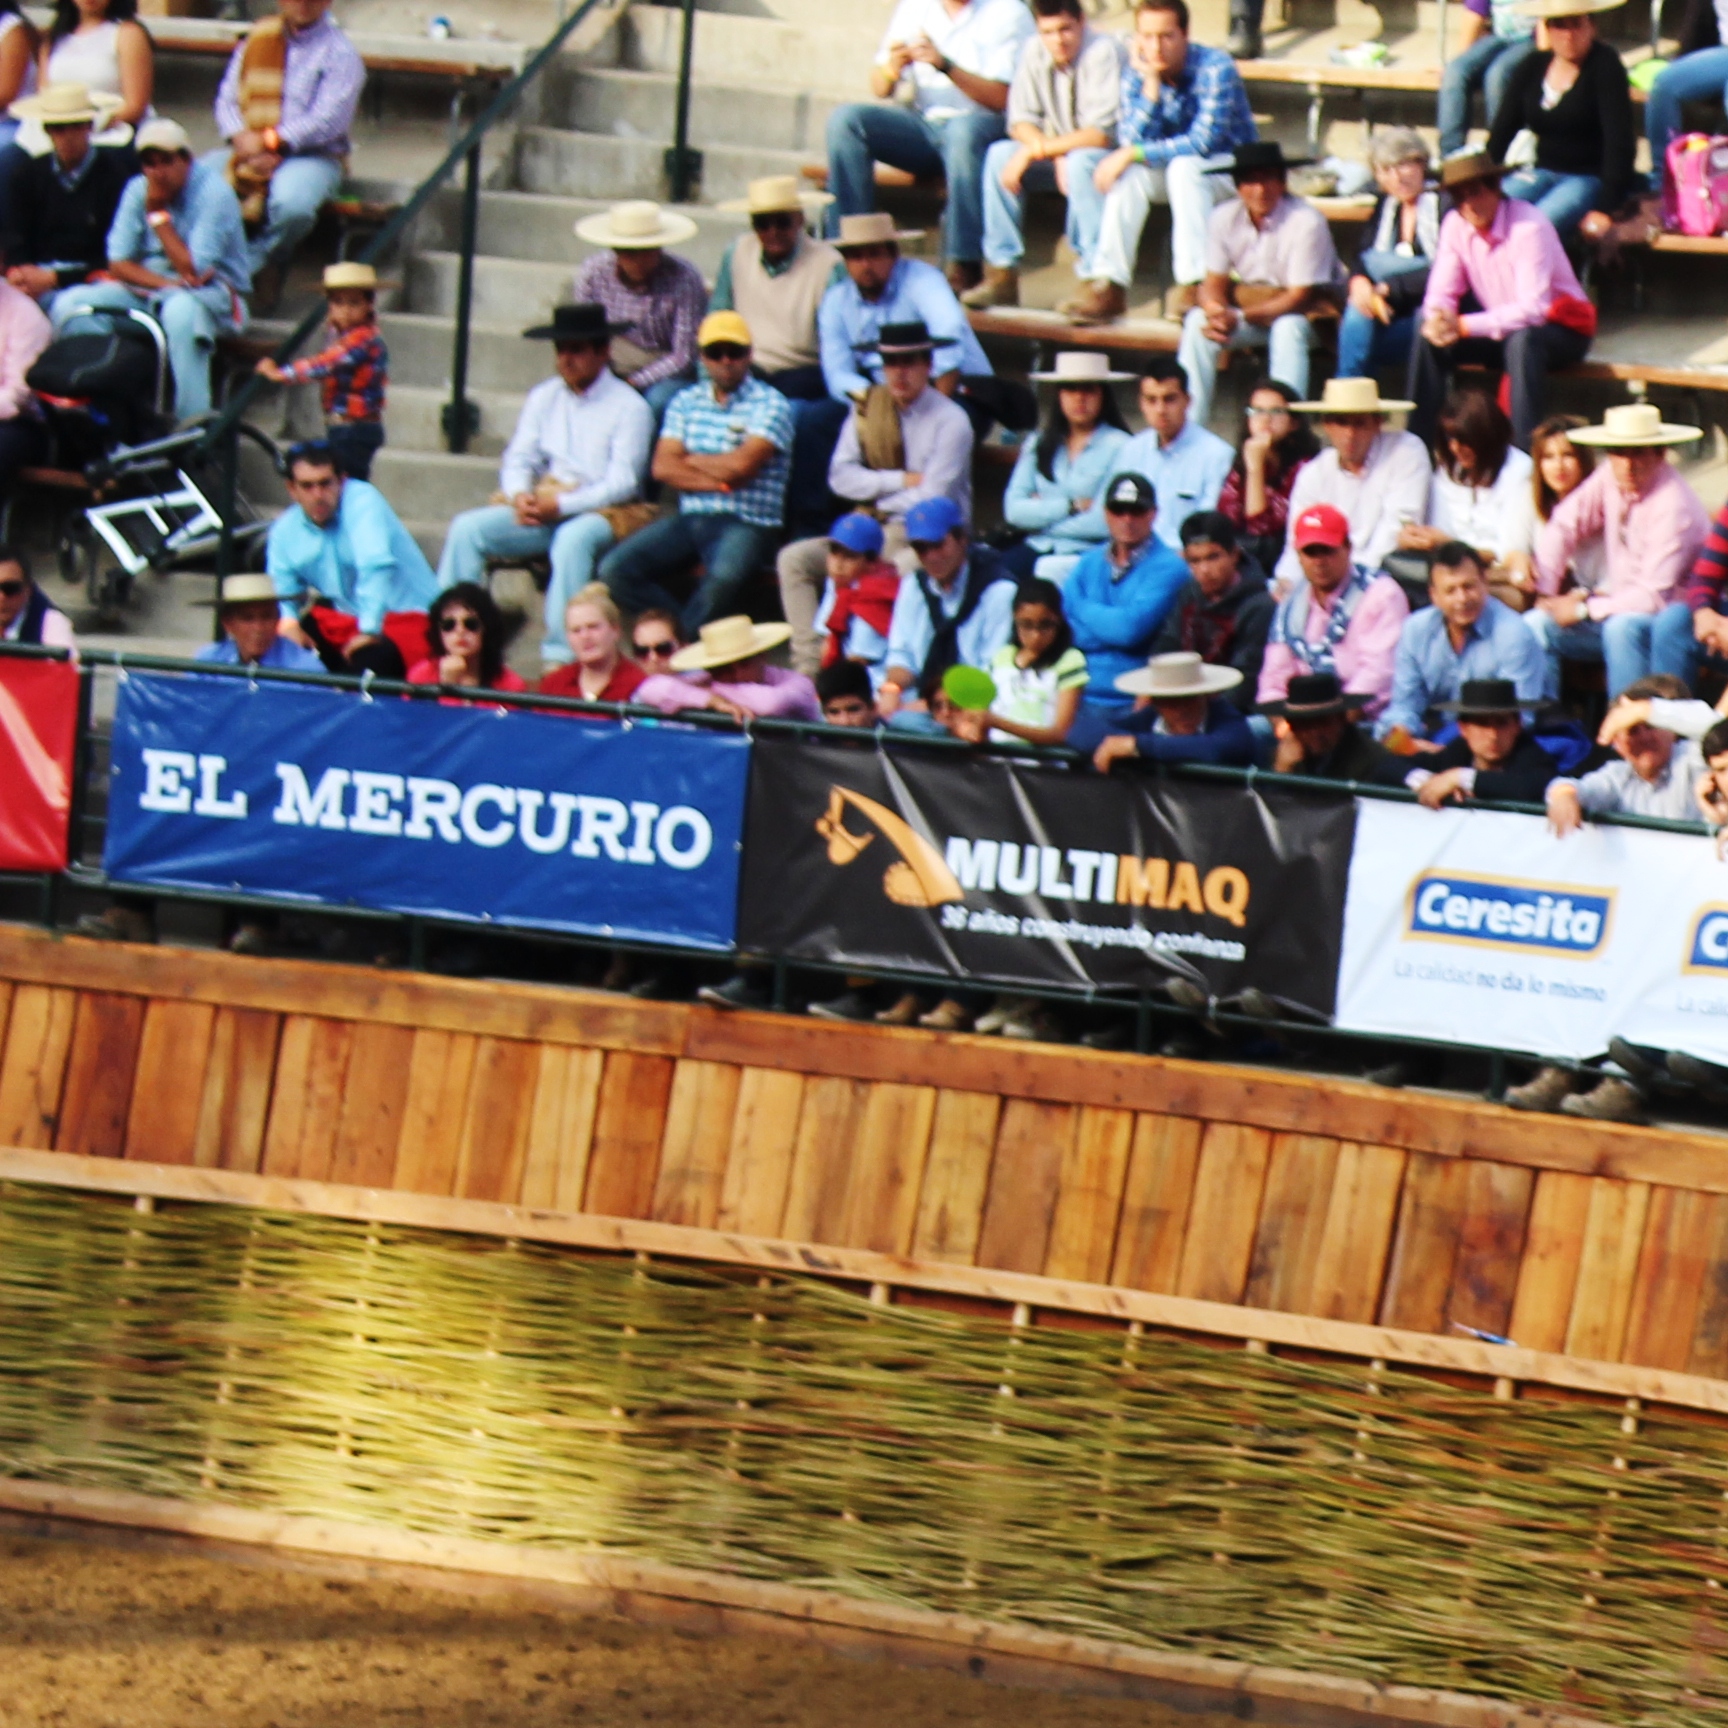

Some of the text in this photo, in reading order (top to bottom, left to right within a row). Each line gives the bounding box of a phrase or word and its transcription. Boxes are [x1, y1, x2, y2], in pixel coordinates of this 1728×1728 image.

[140, 748, 714, 870] EL MERCURIO
[946, 836, 1250, 927] MULTIMAQ
[1154, 930, 1246, 961] confianza
[1416, 882, 1601, 949] Ceresita
[1394, 957, 1412, 977] La
[1416, 960, 1473, 985] calidad
[1477, 972, 1497, 988] no
[1499, 970, 1523, 992] da
[1548, 979, 1607, 1002] mismo
